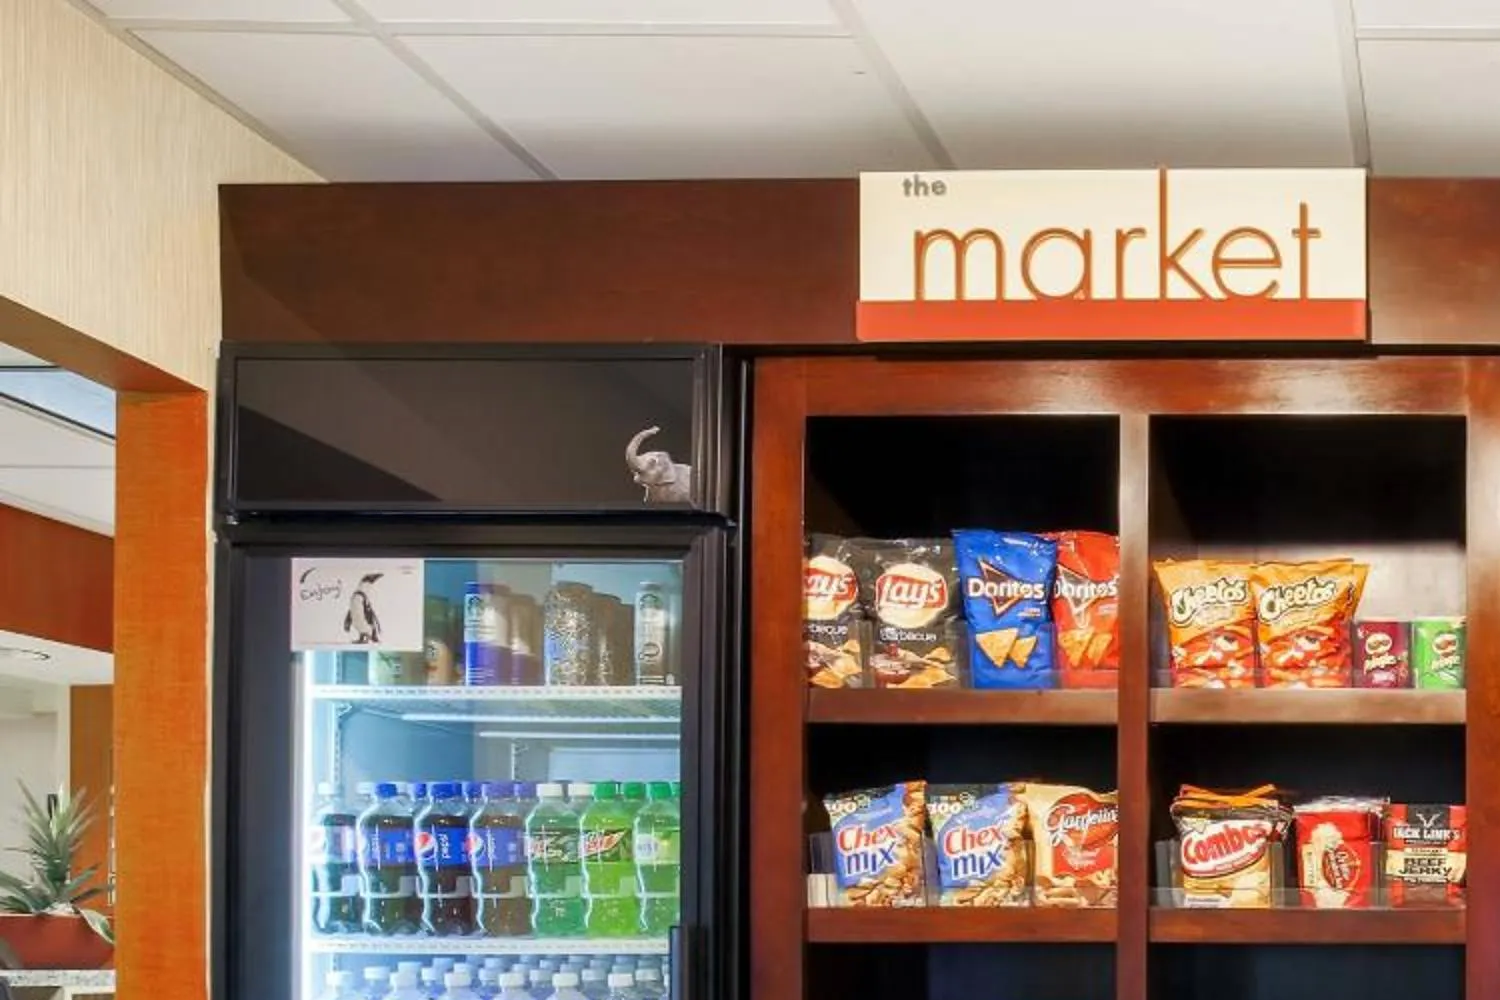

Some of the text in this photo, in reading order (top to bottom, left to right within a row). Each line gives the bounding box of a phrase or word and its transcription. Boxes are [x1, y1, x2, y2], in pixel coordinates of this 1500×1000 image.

[903, 174, 947, 197] the
[913, 167, 1321, 301] market
[967, 577, 1045, 600] Doritos
[1171, 577, 1248, 625] Cheetos
[1258, 576, 1338, 624] Cheetos
[837, 824, 897, 855] Chex
[943, 823, 1002, 857] Chex
[1182, 821, 1271, 864] Combos
